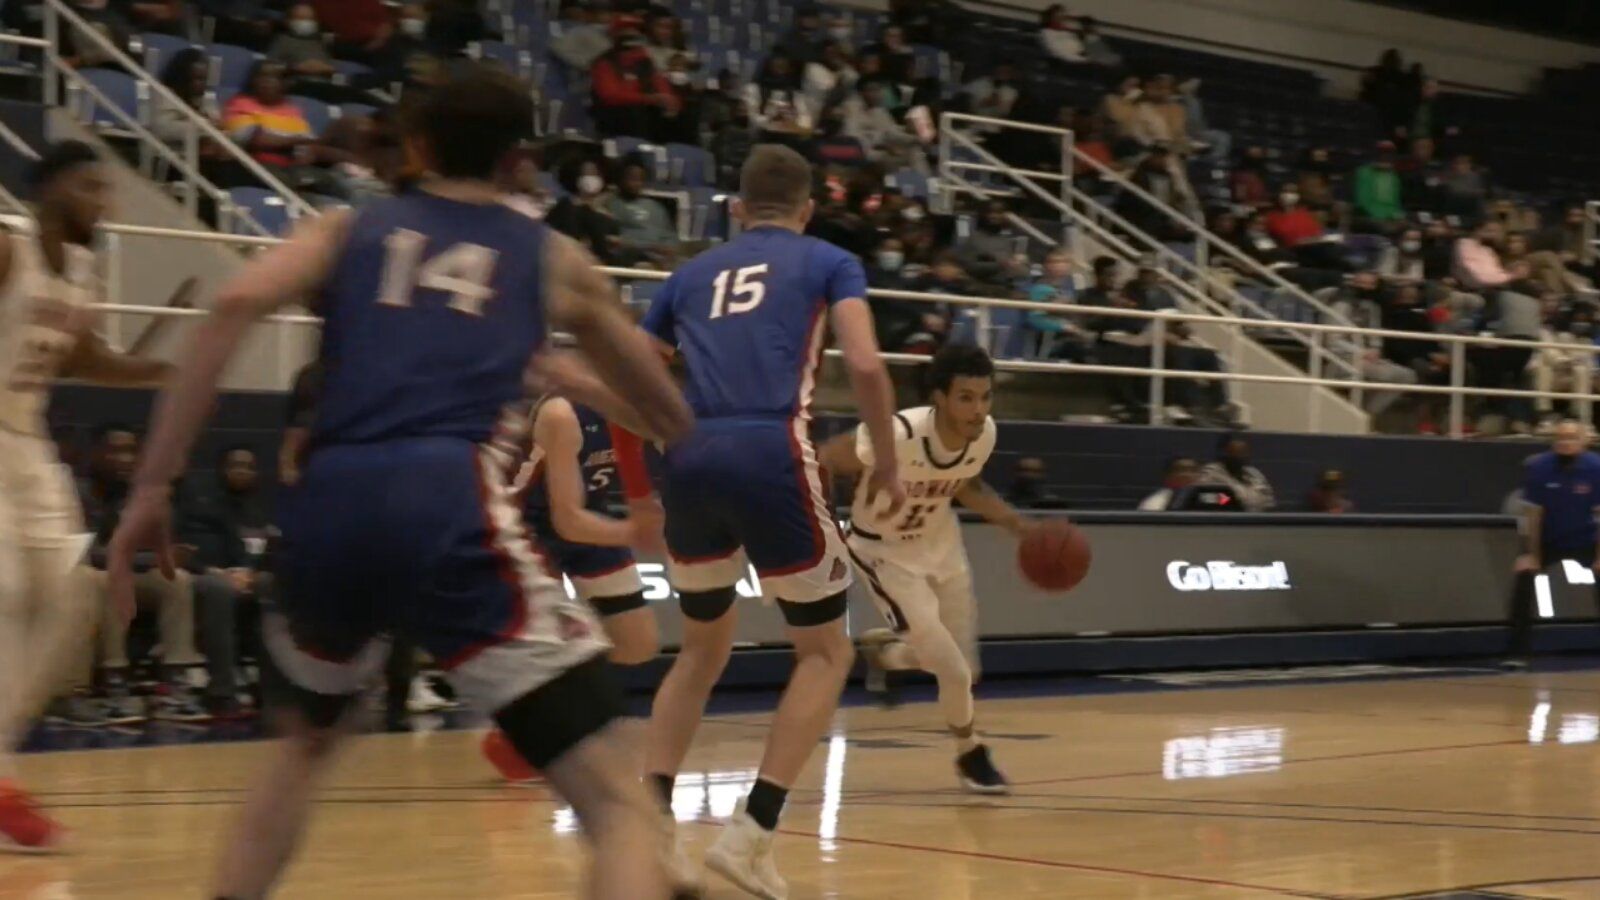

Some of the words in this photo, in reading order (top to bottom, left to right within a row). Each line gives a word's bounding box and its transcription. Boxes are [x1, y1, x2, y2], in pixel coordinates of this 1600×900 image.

[374, 226, 499, 317] 14
[709, 263, 768, 318] 15
[588, 467, 616, 492] 5
[1166, 560, 1211, 591] Go
